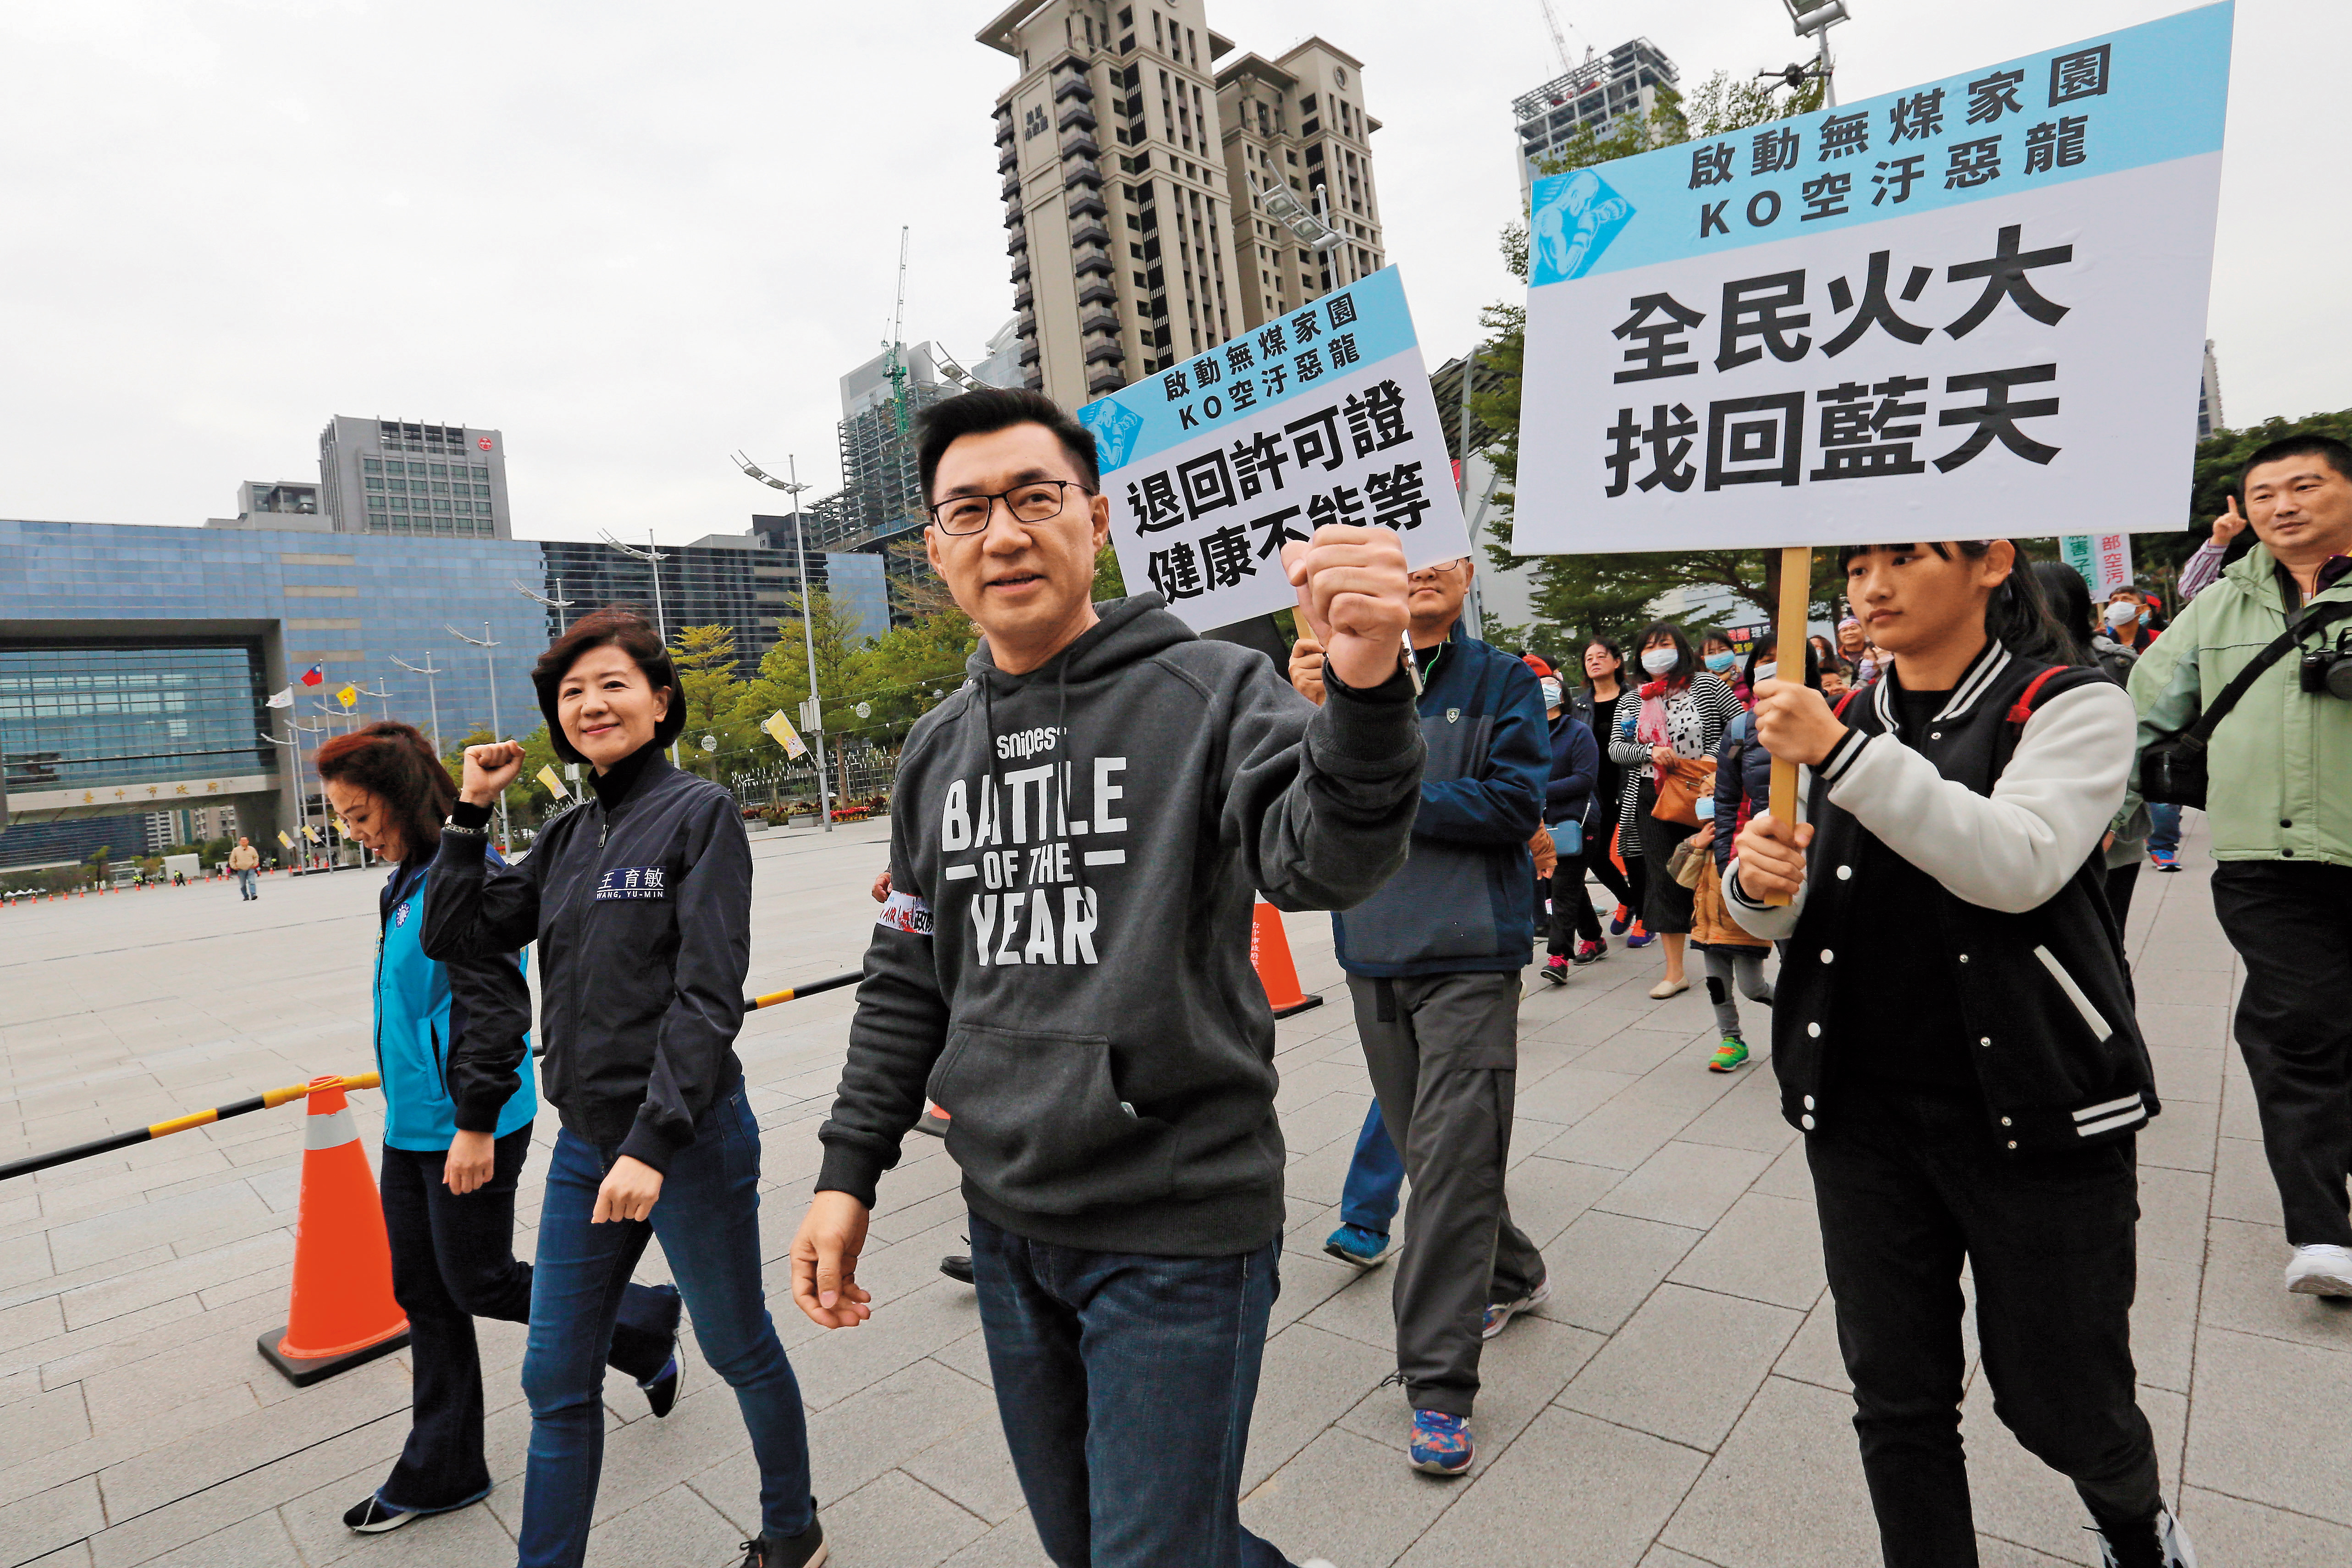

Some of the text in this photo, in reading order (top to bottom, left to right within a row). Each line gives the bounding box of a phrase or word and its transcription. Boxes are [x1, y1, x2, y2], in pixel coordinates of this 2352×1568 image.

[1690, 43, 2111, 189] 啟動無煤家園
[1163, 291, 1358, 402] 啟動無煤家園
[1611, 224, 2073, 384] 全民火大
[1126, 379, 1414, 539] 退回許可證
[1605, 363, 2062, 498] 找回藍天
[942, 756, 1127, 852] BATTLE
[596, 891, 621, 899] WANG,
[598, 868, 664, 890] 王育敏
[983, 842, 1073, 889] OF THE
[971, 886, 1099, 966] YEAR
